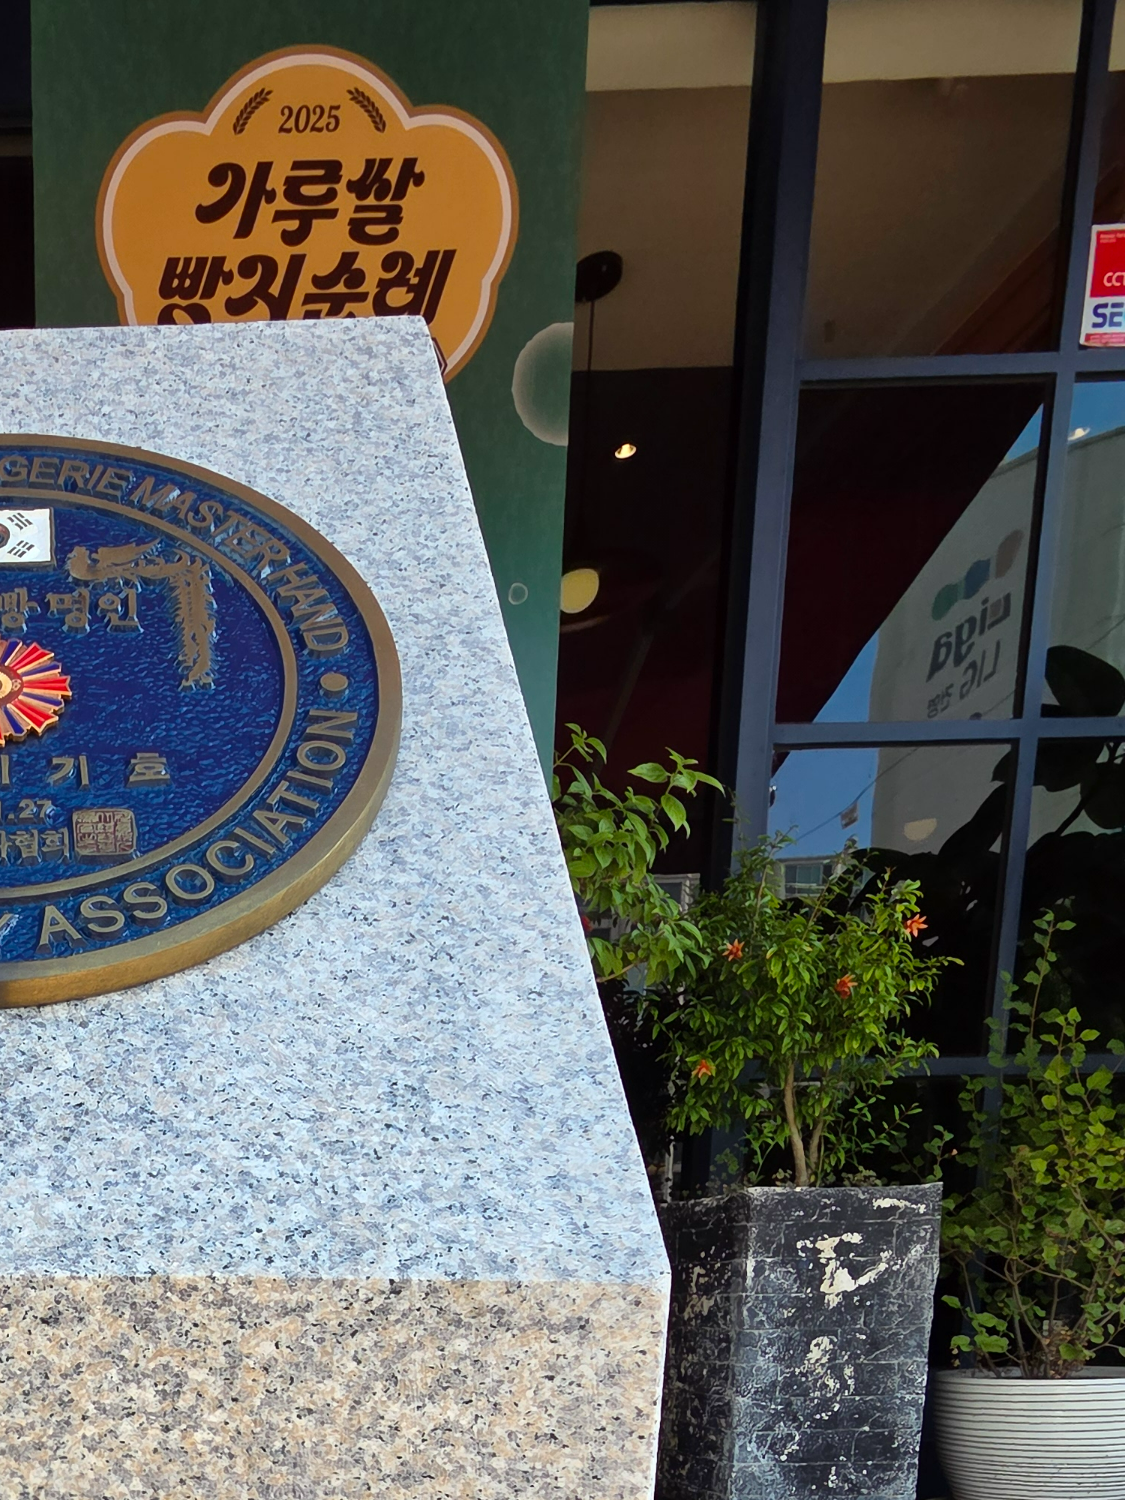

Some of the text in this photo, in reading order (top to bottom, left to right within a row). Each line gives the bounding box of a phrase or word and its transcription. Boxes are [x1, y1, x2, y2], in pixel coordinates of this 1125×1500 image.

[278, 104, 342, 134] 2025
[195, 157, 426, 247] 가루쌀
[157, 249, 458, 326] 빵지순례
[1092, 302, 1125, 328] SE
[131, 476, 291, 573] MASTER
[276, 562, 350, 654] HAND
[45, 587, 142, 633] 명인
[37, 709, 359, 952] ASSOCIATION
